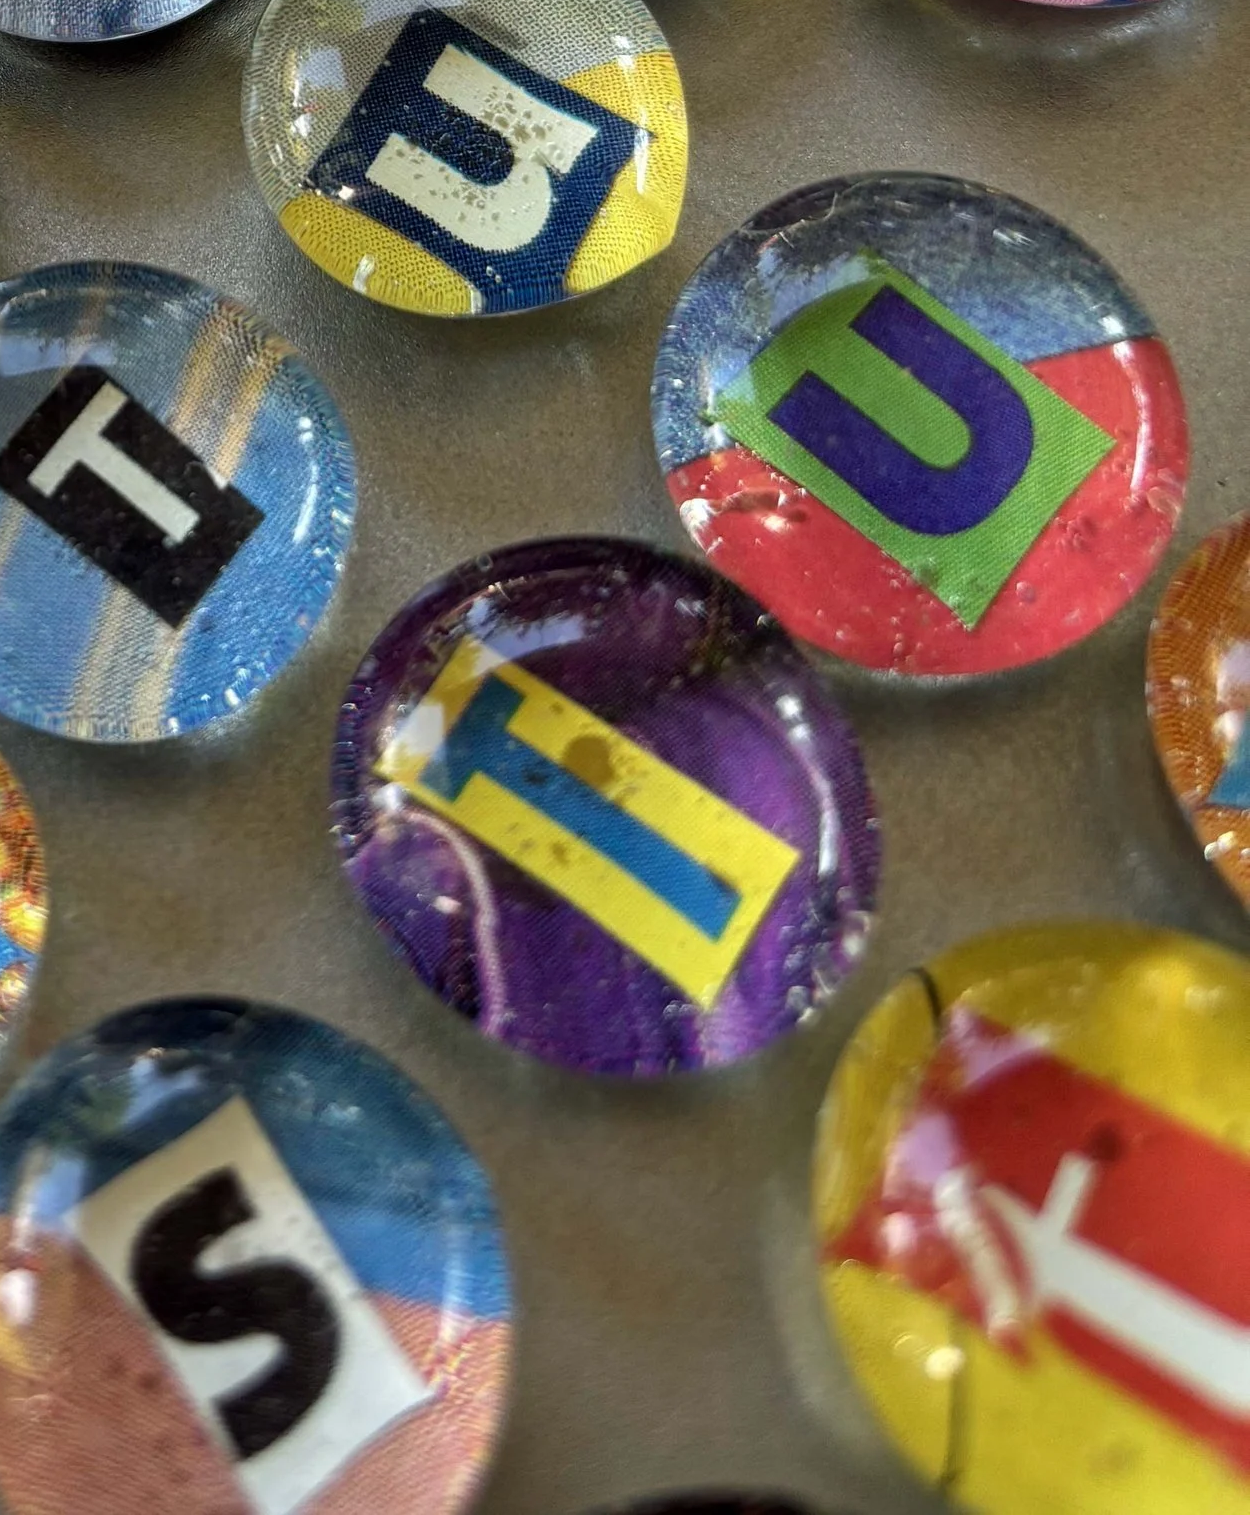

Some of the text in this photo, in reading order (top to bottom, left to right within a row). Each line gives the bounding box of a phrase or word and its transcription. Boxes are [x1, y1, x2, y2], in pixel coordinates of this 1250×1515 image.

[27, 379, 202, 546] T
[766, 284, 1035, 538] U
[421, 674, 742, 943] T
